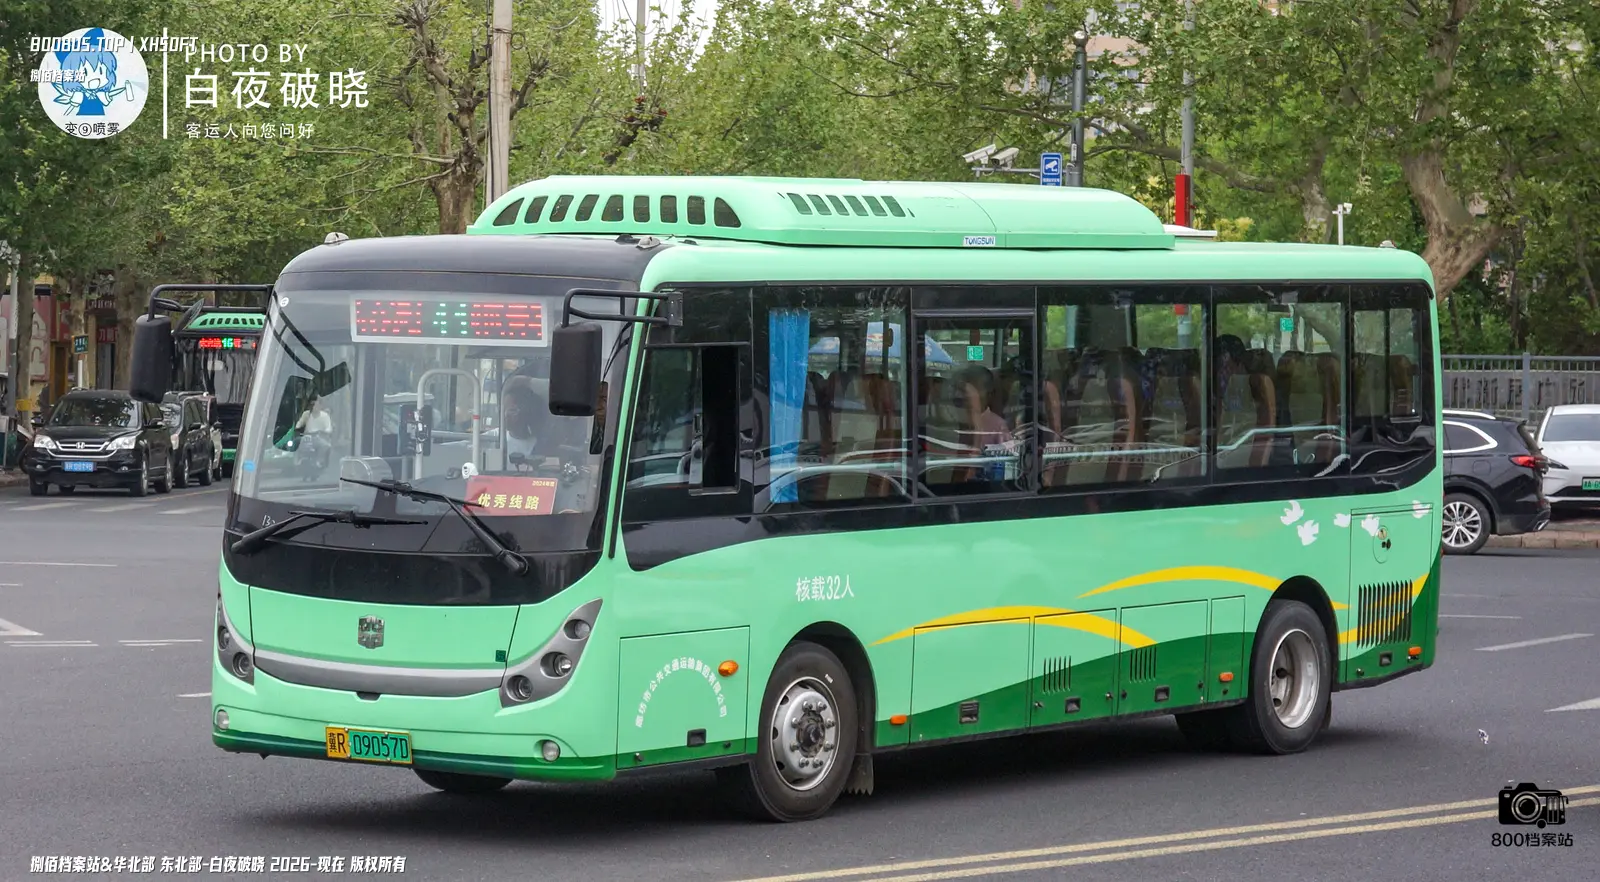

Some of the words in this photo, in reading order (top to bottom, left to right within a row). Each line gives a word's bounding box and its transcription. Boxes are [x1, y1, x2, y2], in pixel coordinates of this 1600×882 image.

[478, 493, 540, 510] 优秀线路
[796, 574, 855, 602] 核载32人
